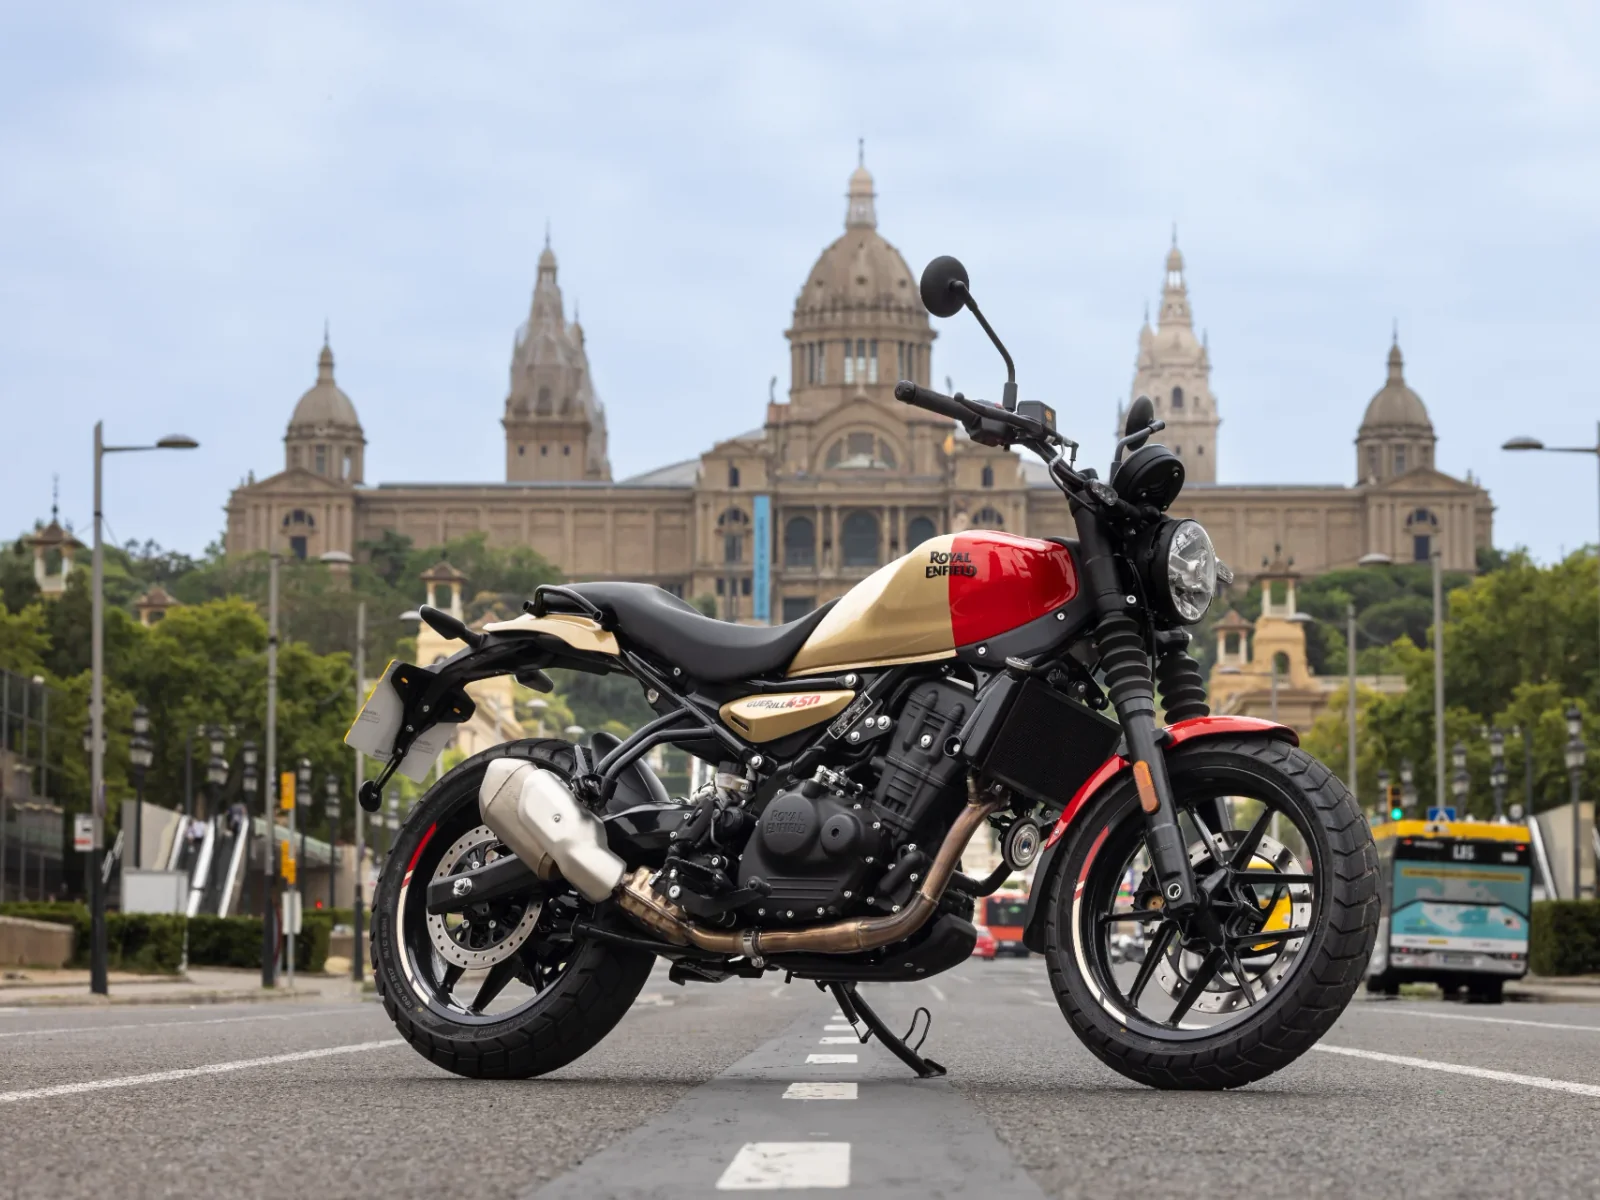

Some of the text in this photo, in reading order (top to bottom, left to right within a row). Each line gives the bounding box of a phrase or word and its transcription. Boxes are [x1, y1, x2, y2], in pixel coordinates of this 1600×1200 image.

[930, 551, 971, 564] ROYAL
[925, 564, 977, 578] ENFIELD
[770, 809, 804, 821] ROYAL
[765, 822, 807, 834] ENFIELD
